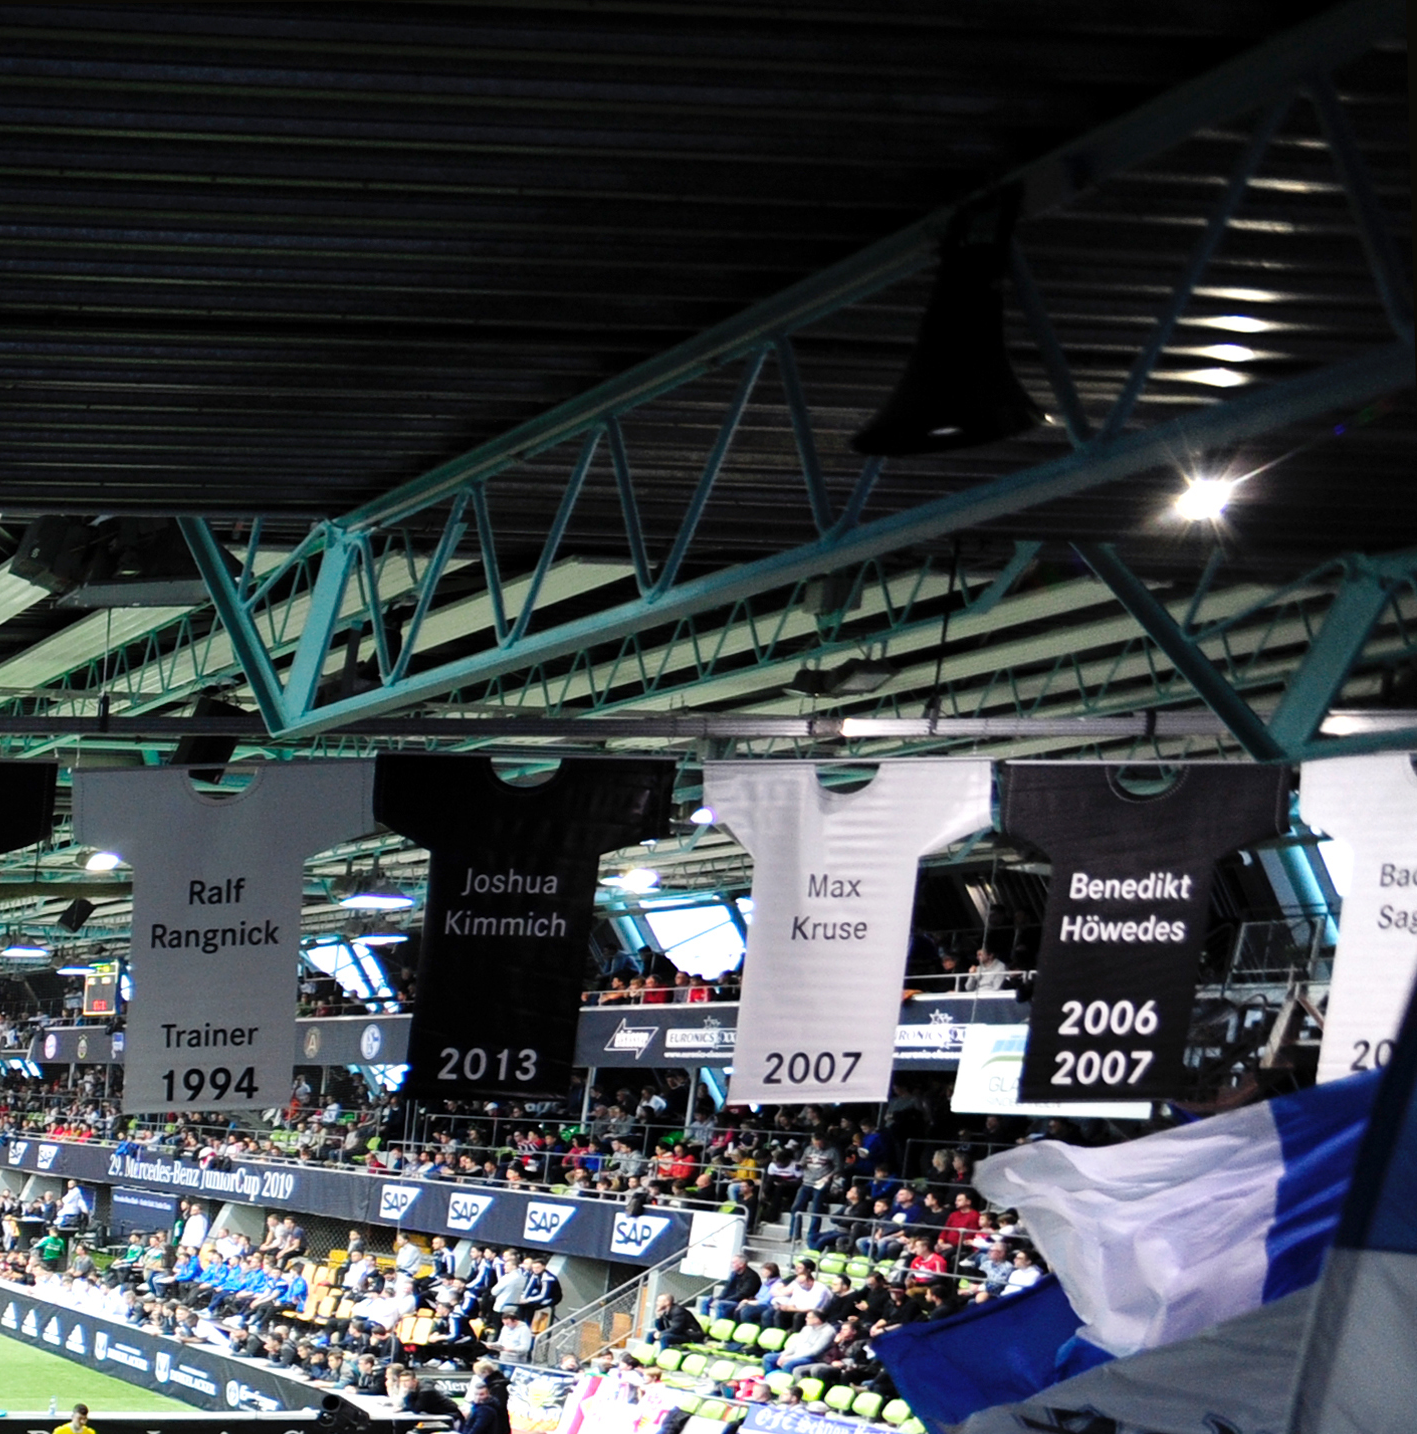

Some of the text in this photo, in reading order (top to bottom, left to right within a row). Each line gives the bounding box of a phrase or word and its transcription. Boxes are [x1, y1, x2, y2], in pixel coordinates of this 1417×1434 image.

[188, 877, 245, 904] Ralf
[460, 867, 558, 896] Joshua
[808, 873, 862, 898] Max
[1069, 872, 1192, 900] Benedikt
[150, 920, 279, 953] Rangnick
[444, 908, 566, 938] Kimmich
[790, 915, 868, 941] Kruse
[1060, 915, 1185, 943] Höwedes
[1058, 1000, 1158, 1035] 2006
[161, 1022, 258, 1048] Trainer
[437, 1047, 537, 1081] 2013
[763, 1051, 863, 1084] 2007
[1051, 1050, 1154, 1085] 2007
[162, 1067, 259, 1101] 1994
[108, 1153, 294, 1201] 29. Mercedes-Benz JuniorCup 2019
[382, 1190, 408, 1212] SAP
[450, 1199, 479, 1222] SAP
[528, 1210, 560, 1233] SAP
[615, 1221, 652, 1247] SAP
